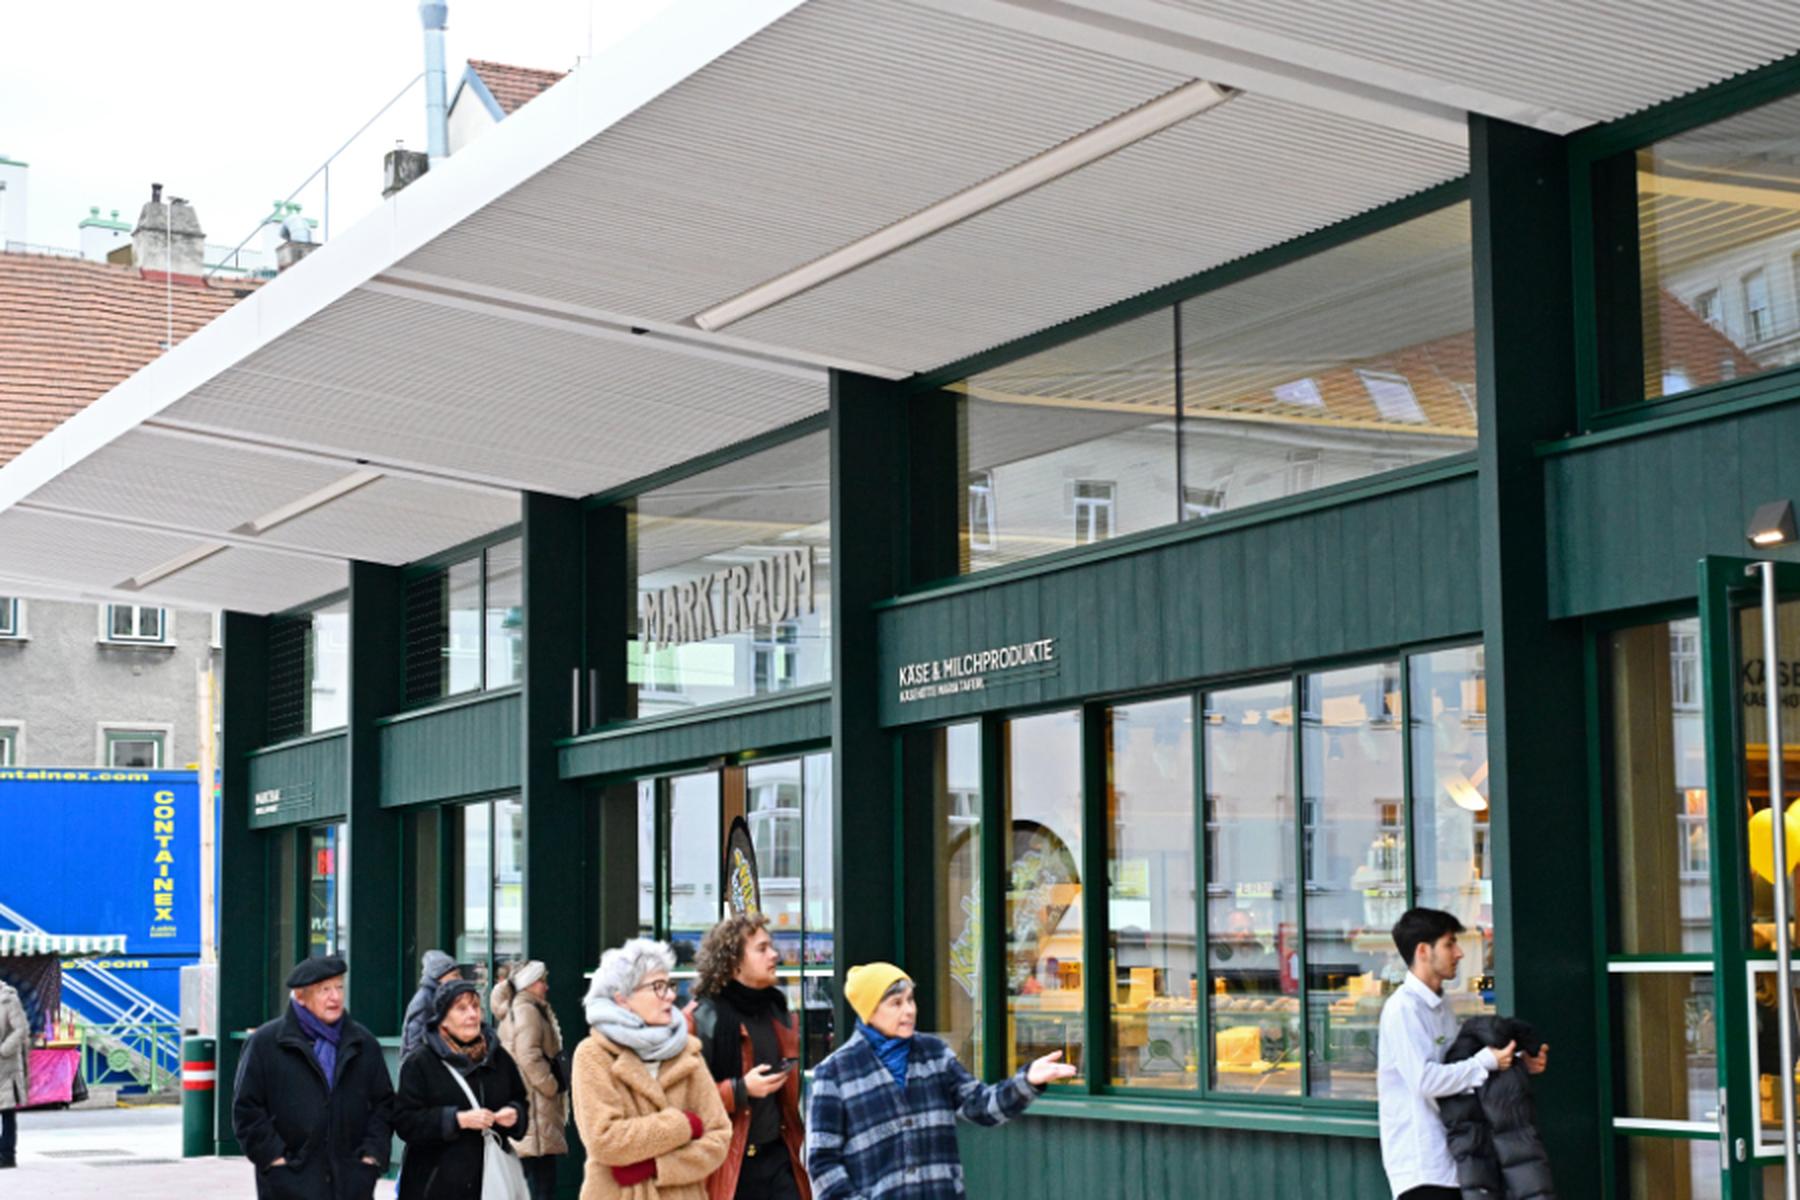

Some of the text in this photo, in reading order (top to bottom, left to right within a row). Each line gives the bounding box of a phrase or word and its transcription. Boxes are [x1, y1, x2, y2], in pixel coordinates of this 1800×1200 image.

[643, 546, 815, 654] MARKTRAUM
[899, 638, 1054, 687] KÄSE & MILCHPRODUKTE
[154, 790, 175, 921] CONTAINEX
